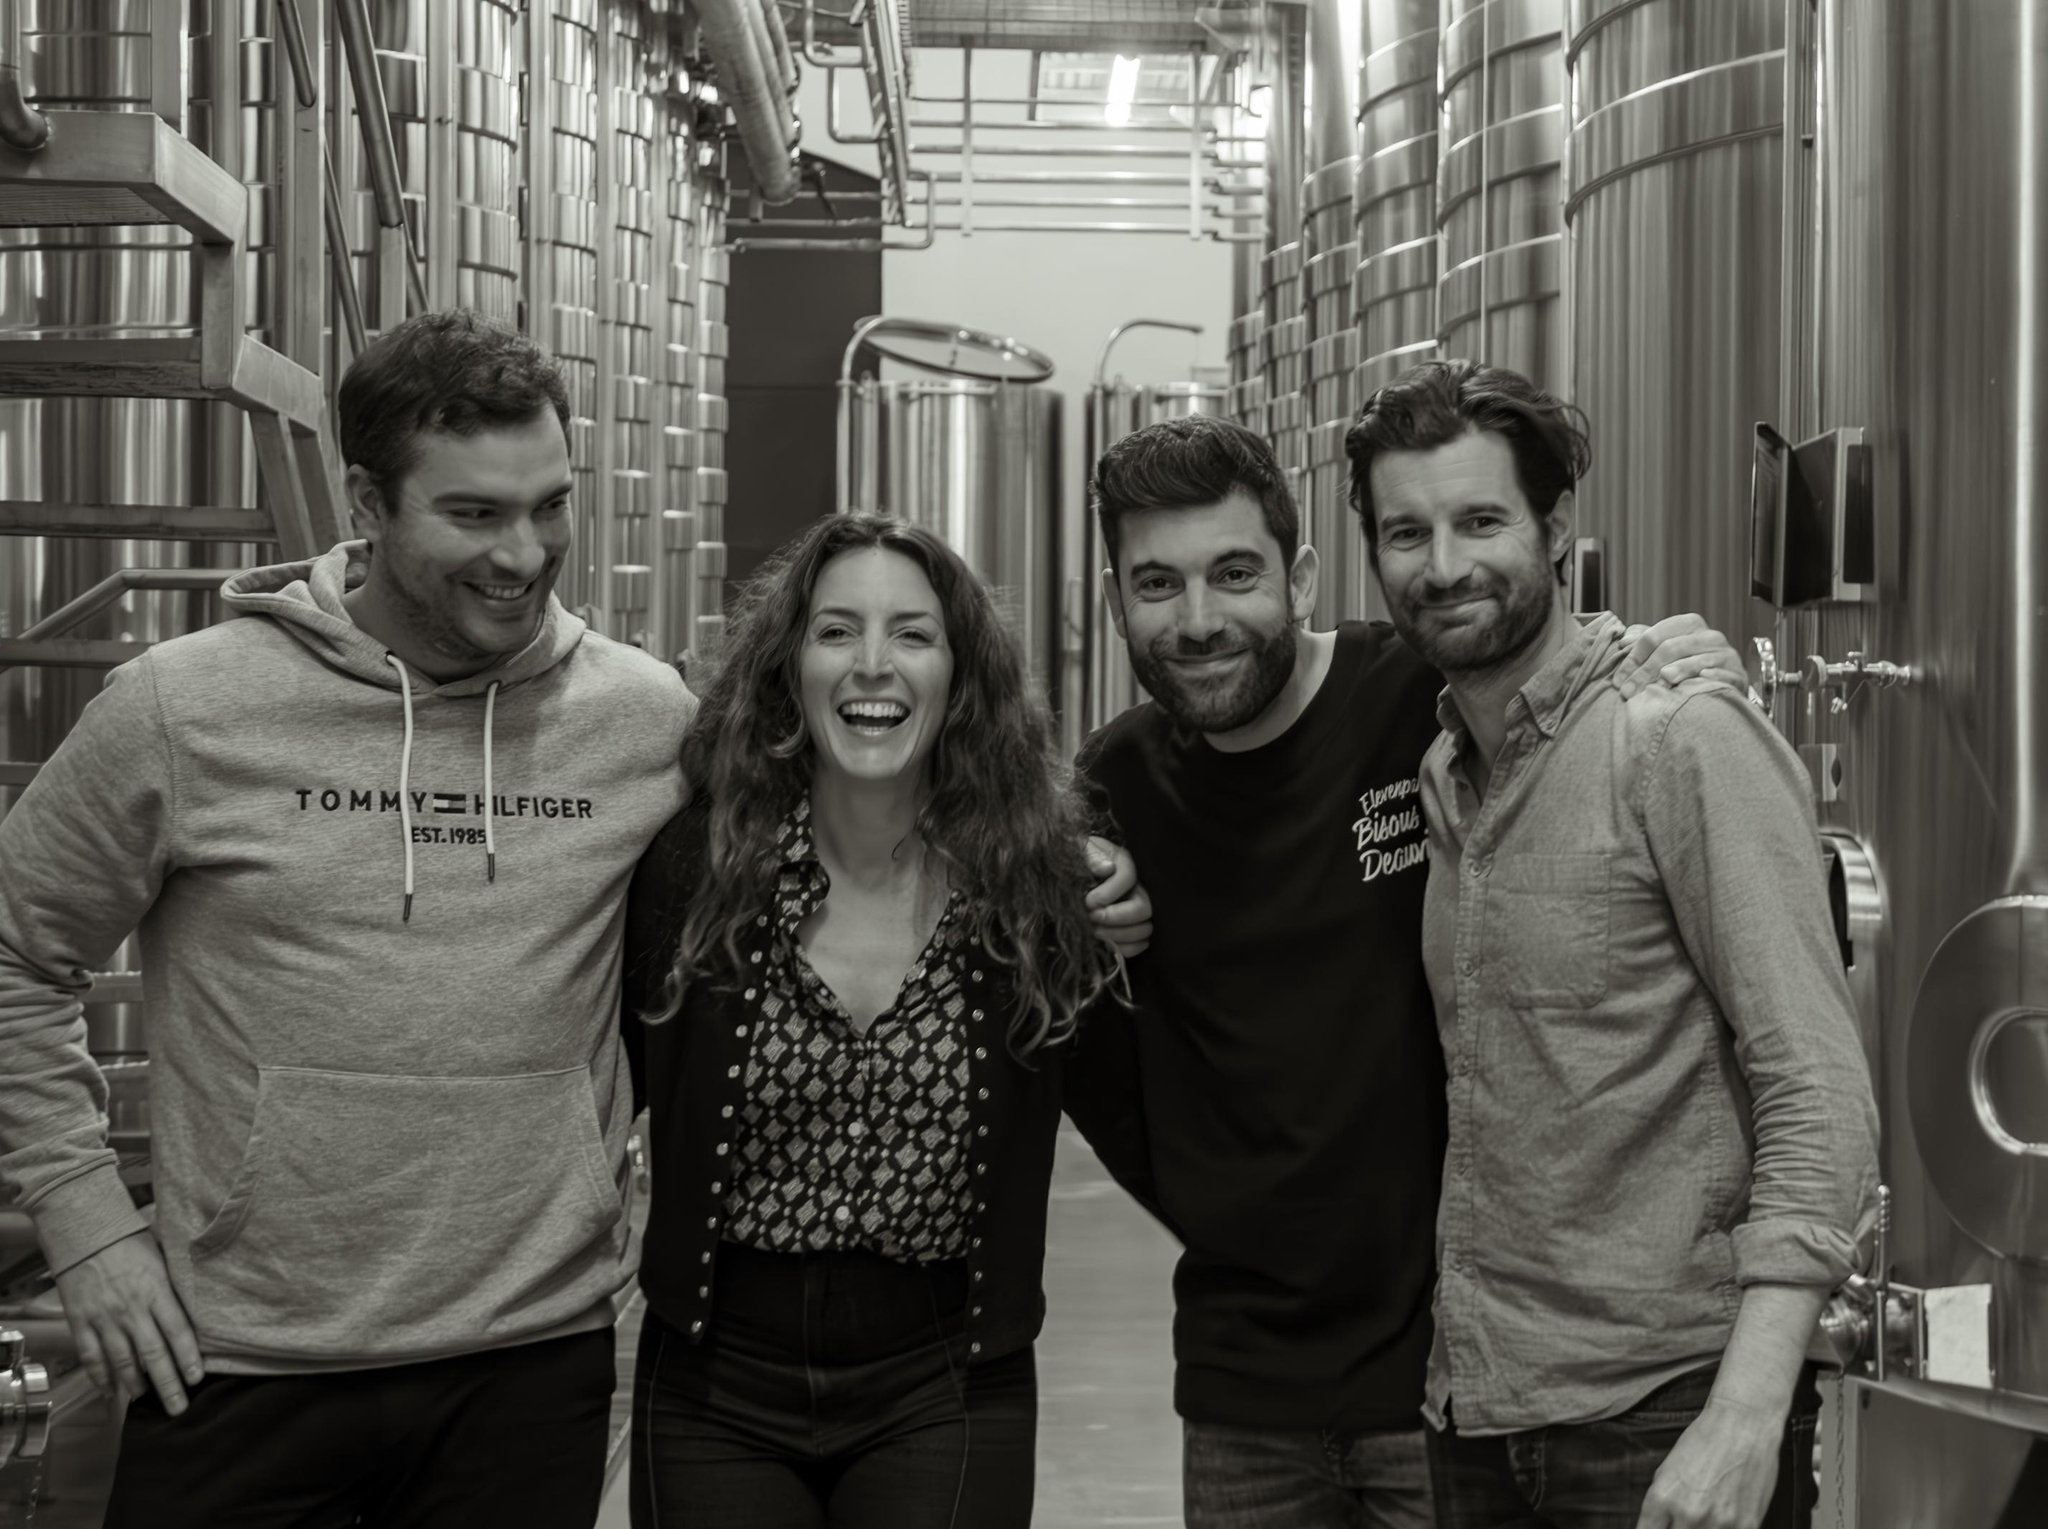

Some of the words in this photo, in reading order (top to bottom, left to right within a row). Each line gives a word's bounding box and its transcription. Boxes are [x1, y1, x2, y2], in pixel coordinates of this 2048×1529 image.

[295, 789, 428, 813] TOMMY
[474, 794, 593, 819] HILFIGER
[411, 826, 448, 844] EST.
[449, 827, 487, 845] 1985
[1351, 804, 1420, 852] Bisous
